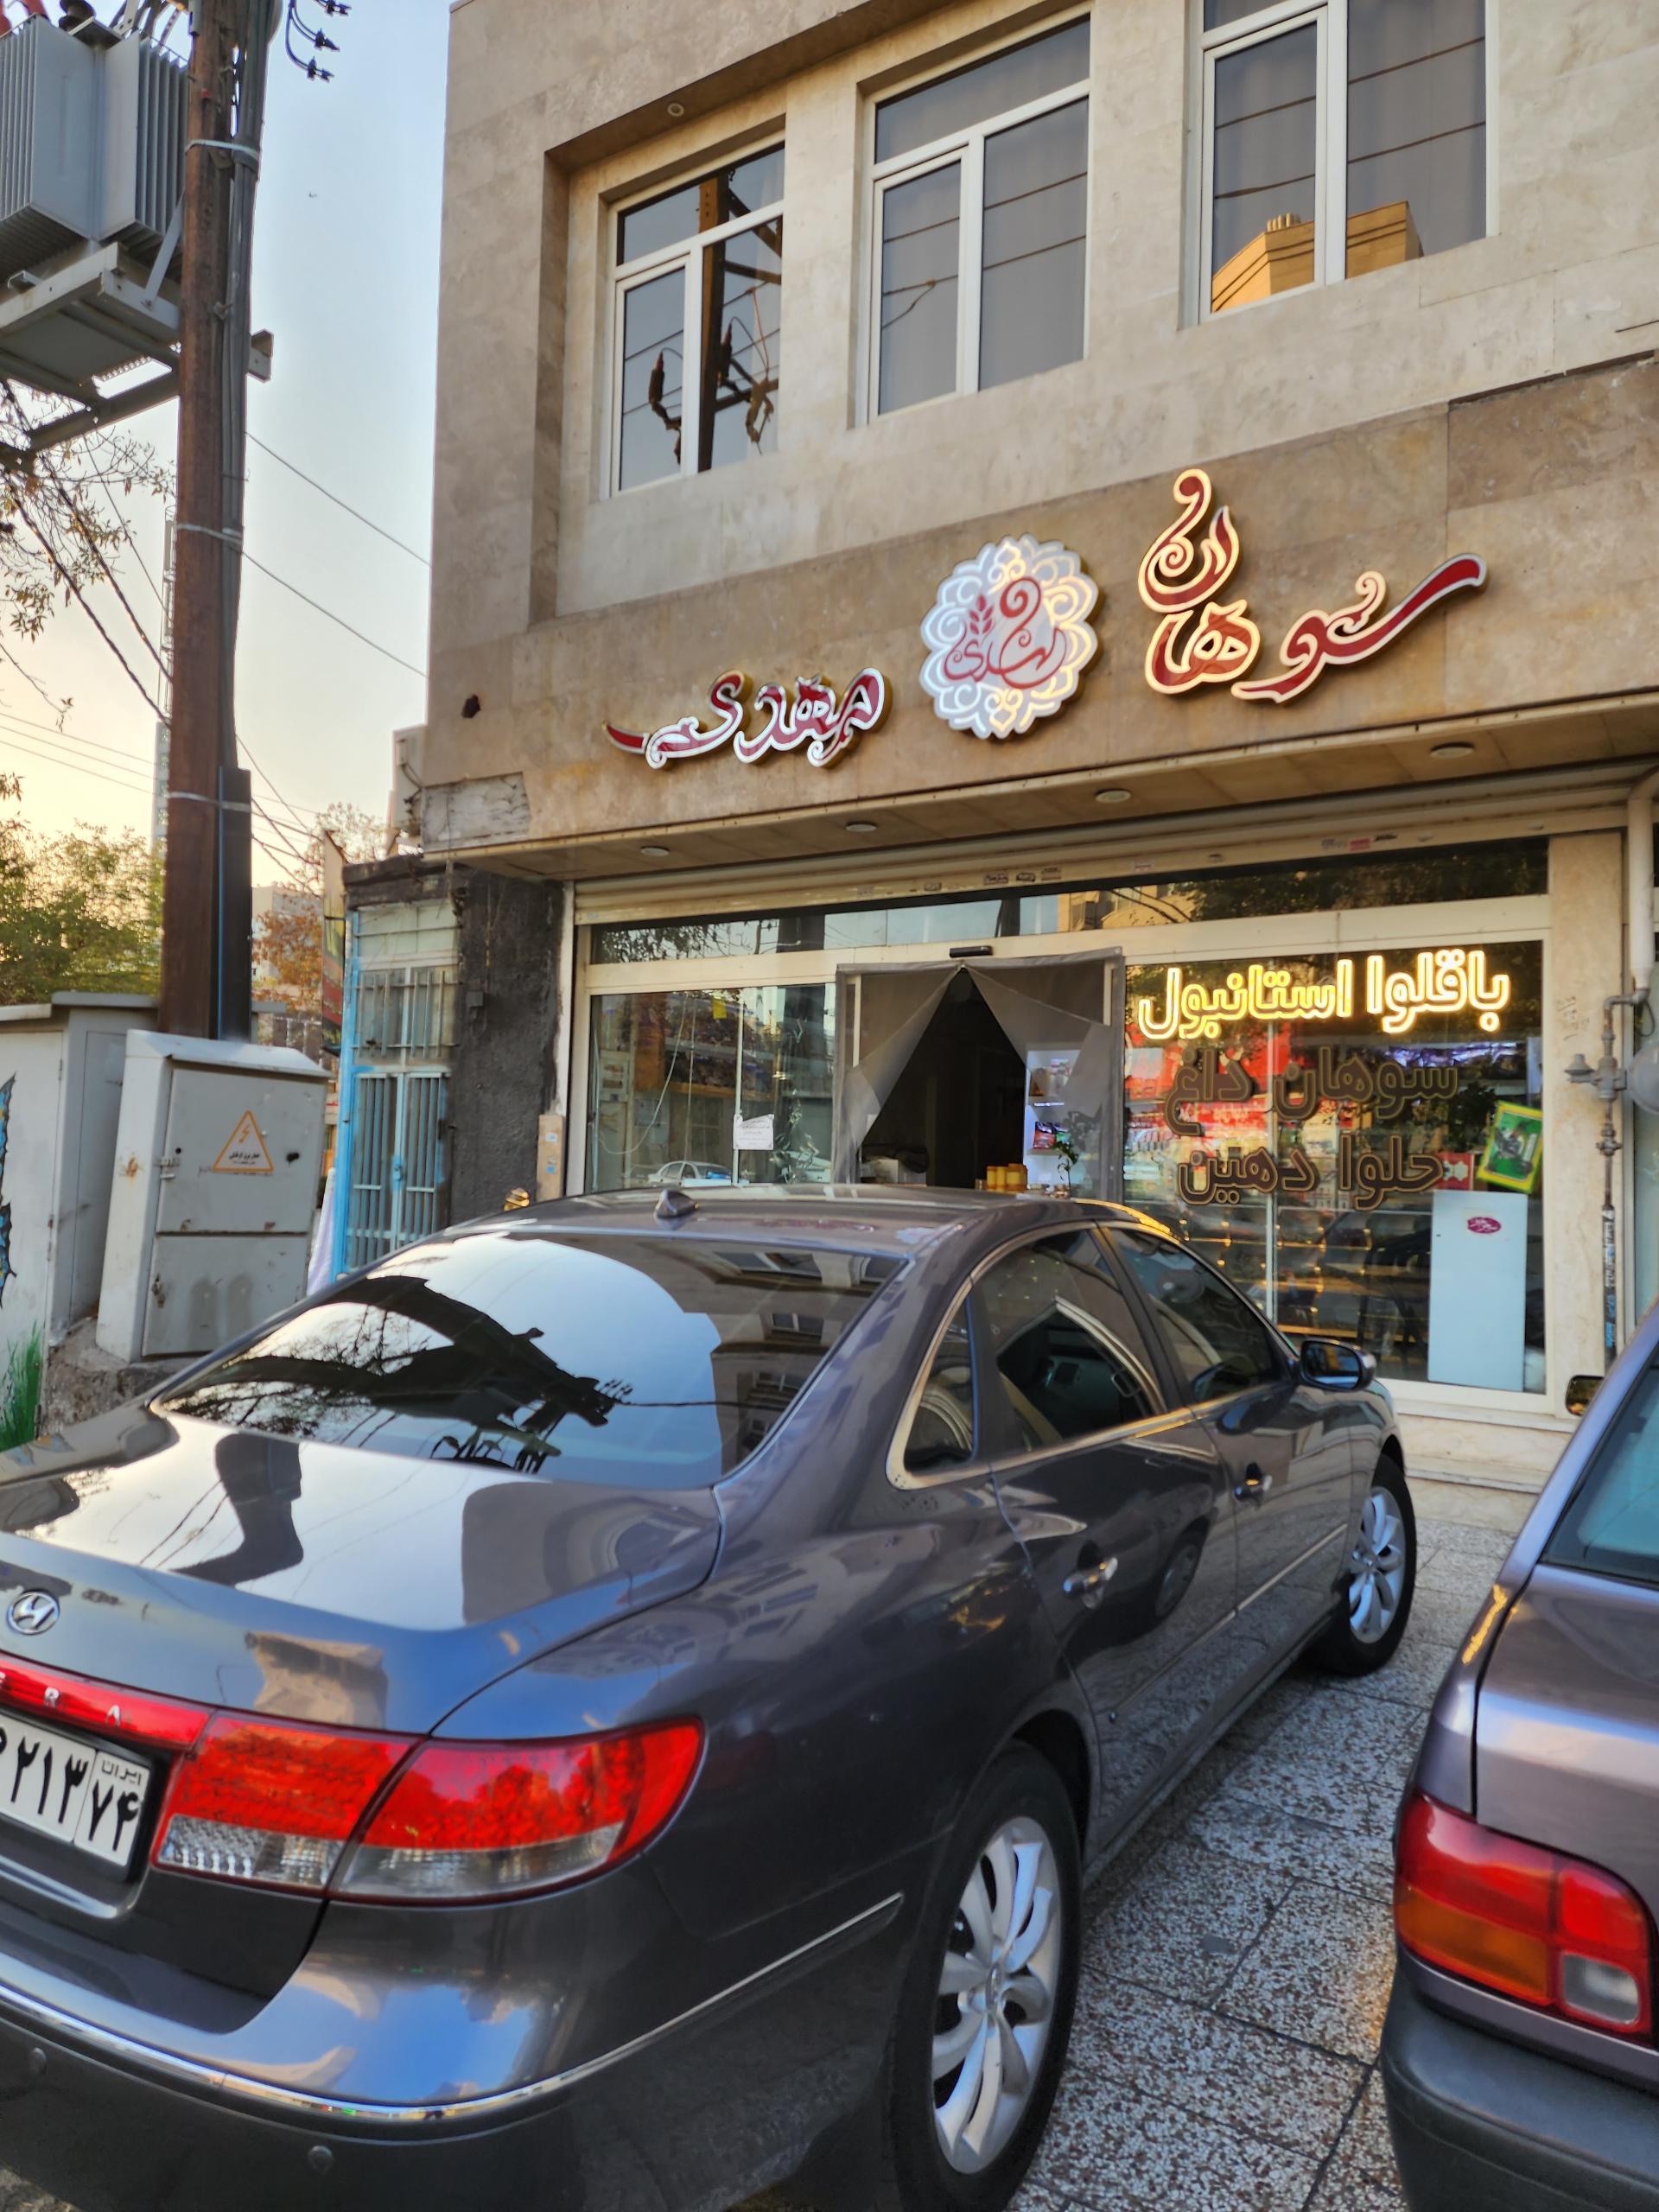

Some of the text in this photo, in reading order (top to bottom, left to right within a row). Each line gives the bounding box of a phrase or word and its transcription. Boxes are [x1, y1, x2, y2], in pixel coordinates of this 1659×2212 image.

[1138, 468, 1487, 703] سوهان
[1138, 959, 1353, 1039] استانبول
[1366, 948, 1510, 1034] باقلوا
[1164, 1046, 1459, 1137] سوهان داغ
[1177, 1133, 1444, 1211] حلوا دهین
